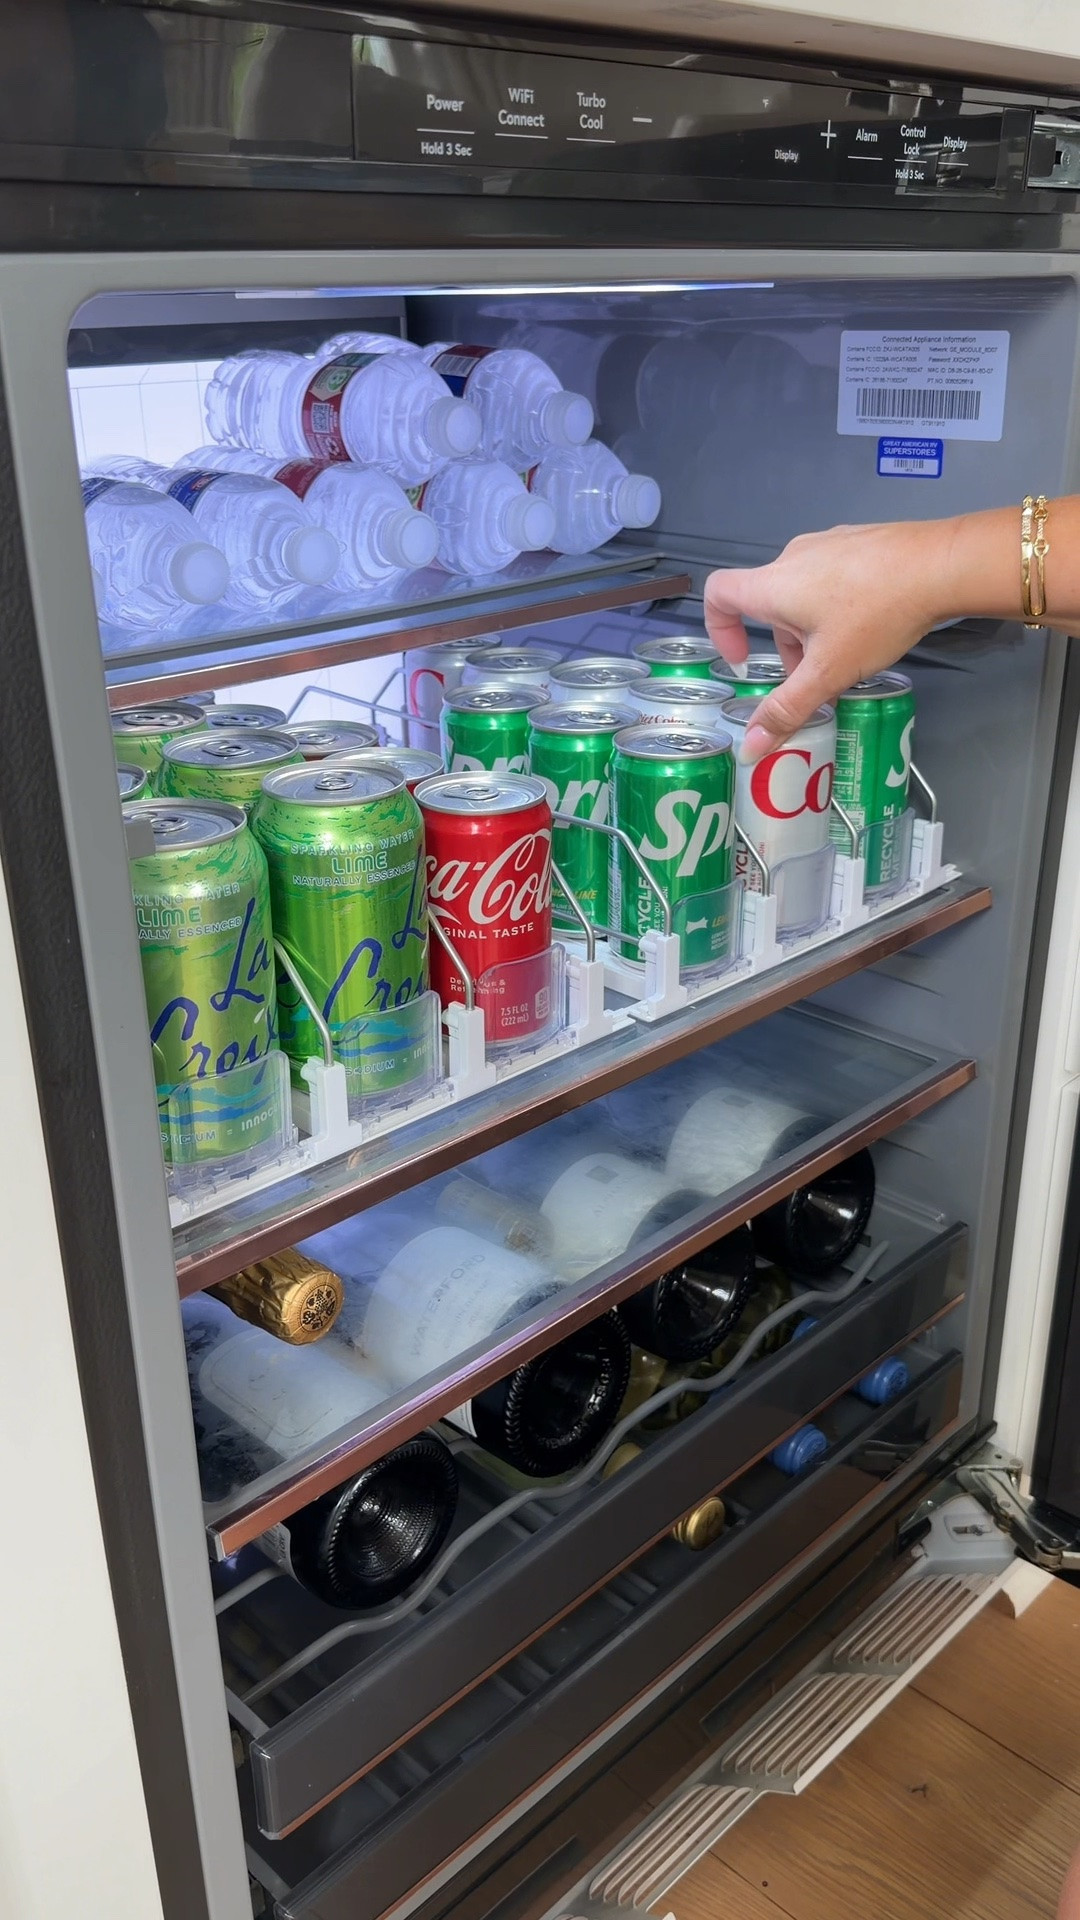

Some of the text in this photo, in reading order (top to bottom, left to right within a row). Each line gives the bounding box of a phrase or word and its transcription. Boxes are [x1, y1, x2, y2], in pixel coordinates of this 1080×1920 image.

[426, 94, 465, 112] Power
[508, 88, 535, 105] WiFi
[576, 92, 607, 109] Turbo
[498, 110, 546, 127] Connect
[579, 114, 604, 130] Cool
[856, 128, 878, 143] Alarm
[900, 125, 927, 139] Control
[420, 141, 473, 157] Hold 3 Sec
[903, 143, 921, 156] Lock
[943, 135, 968, 153] Display
[774, 149, 799, 163] Display
[895, 169, 925, 181] Hold 3 Sec
[882, 335, 912, 343] Connected
[913, 335, 942, 344] Appliance
[883, 447, 937, 456] SUPERSTORES
[291, 828, 415, 856] SPARKLING WATER
[331, 851, 389, 876] LIME
[293, 874, 361, 887] NATURALLY
[137, 906, 202, 928] LIME
[178, 916, 243, 939] ESSENCED
[492, 922, 535, 940] TASTE
[210, 896, 271, 1013] La
[501, 1007, 511, 1017] 7.5
[512, 1005, 520, 1014] FL
[521, 1003, 529, 1013] OZ
[501, 1013, 529, 1027] (222 mL)
